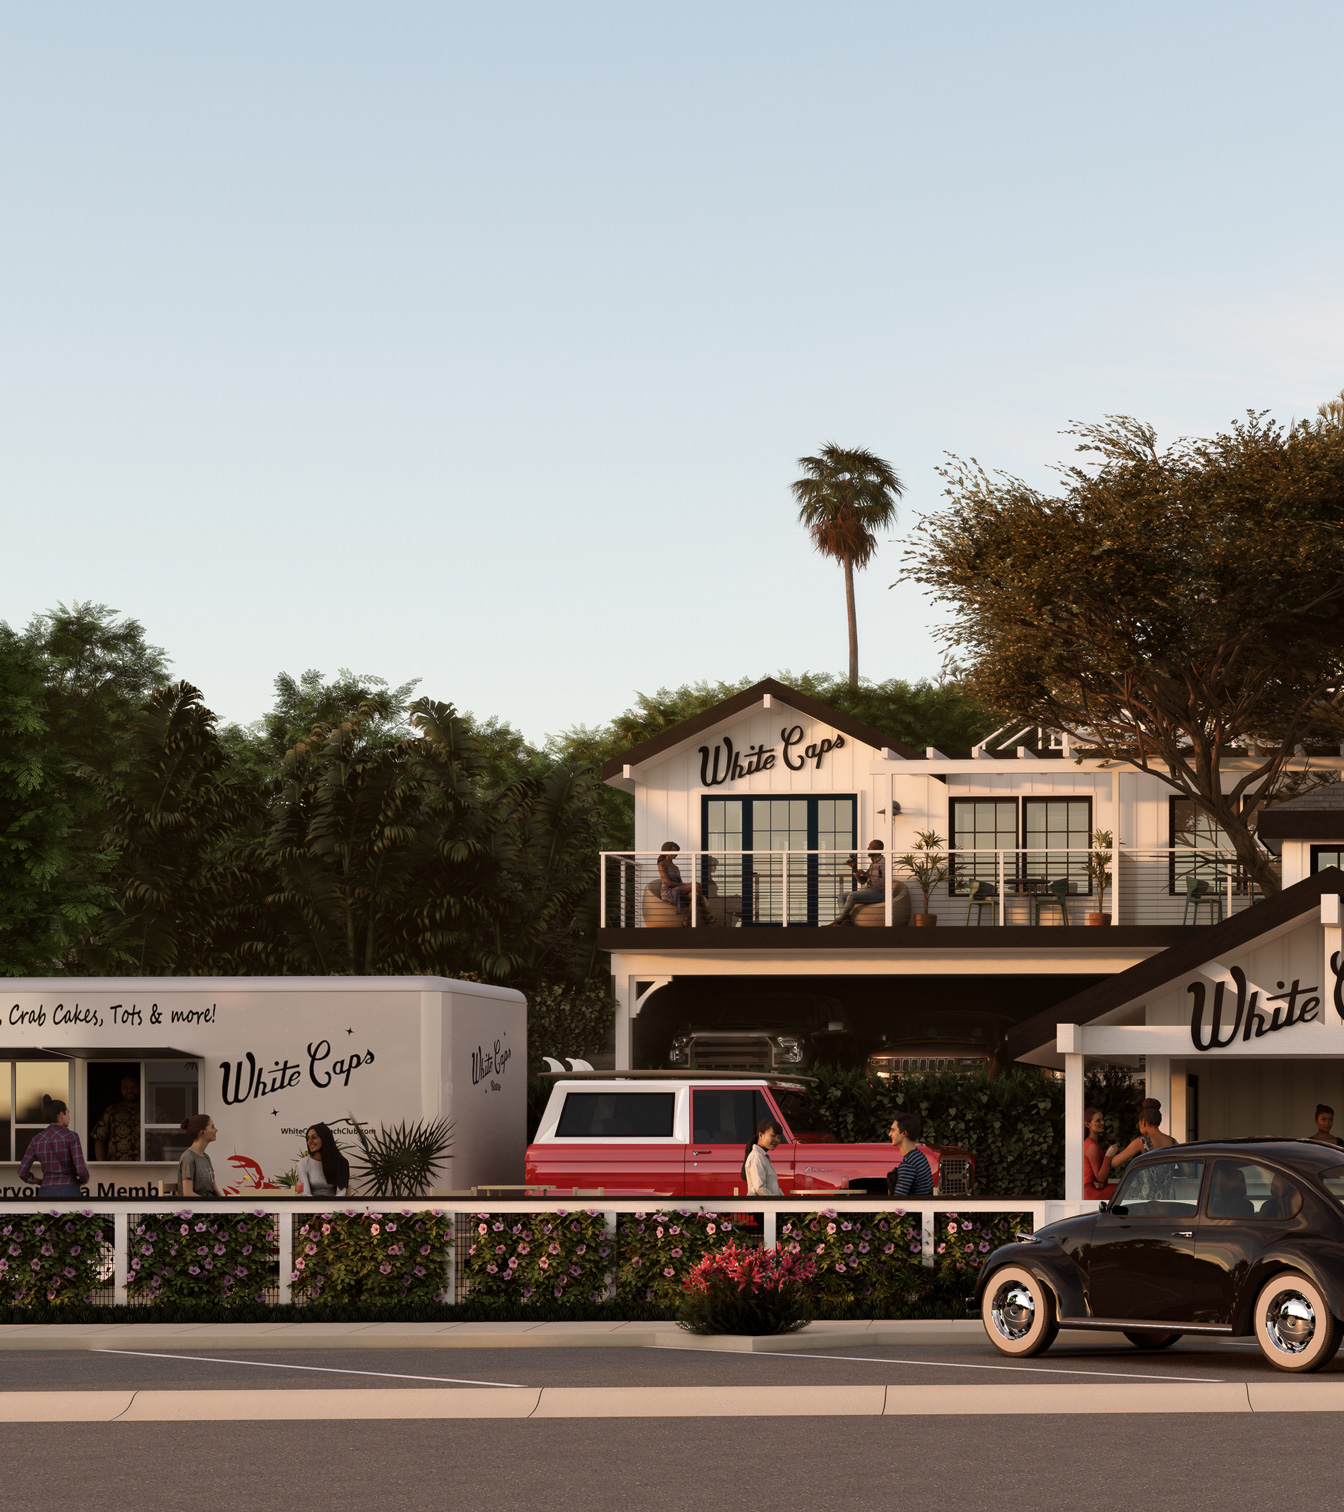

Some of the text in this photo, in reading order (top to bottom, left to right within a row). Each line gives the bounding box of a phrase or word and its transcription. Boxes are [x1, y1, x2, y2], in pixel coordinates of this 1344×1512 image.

[698, 725, 846, 787] White Caps
[8, 1003, 217, 1027] Crab Cakes, Tots & more!
[1187, 965, 1321, 1052] White
[219, 1040, 375, 1106] White Caps
[471, 1039, 512, 1086] White Caps
